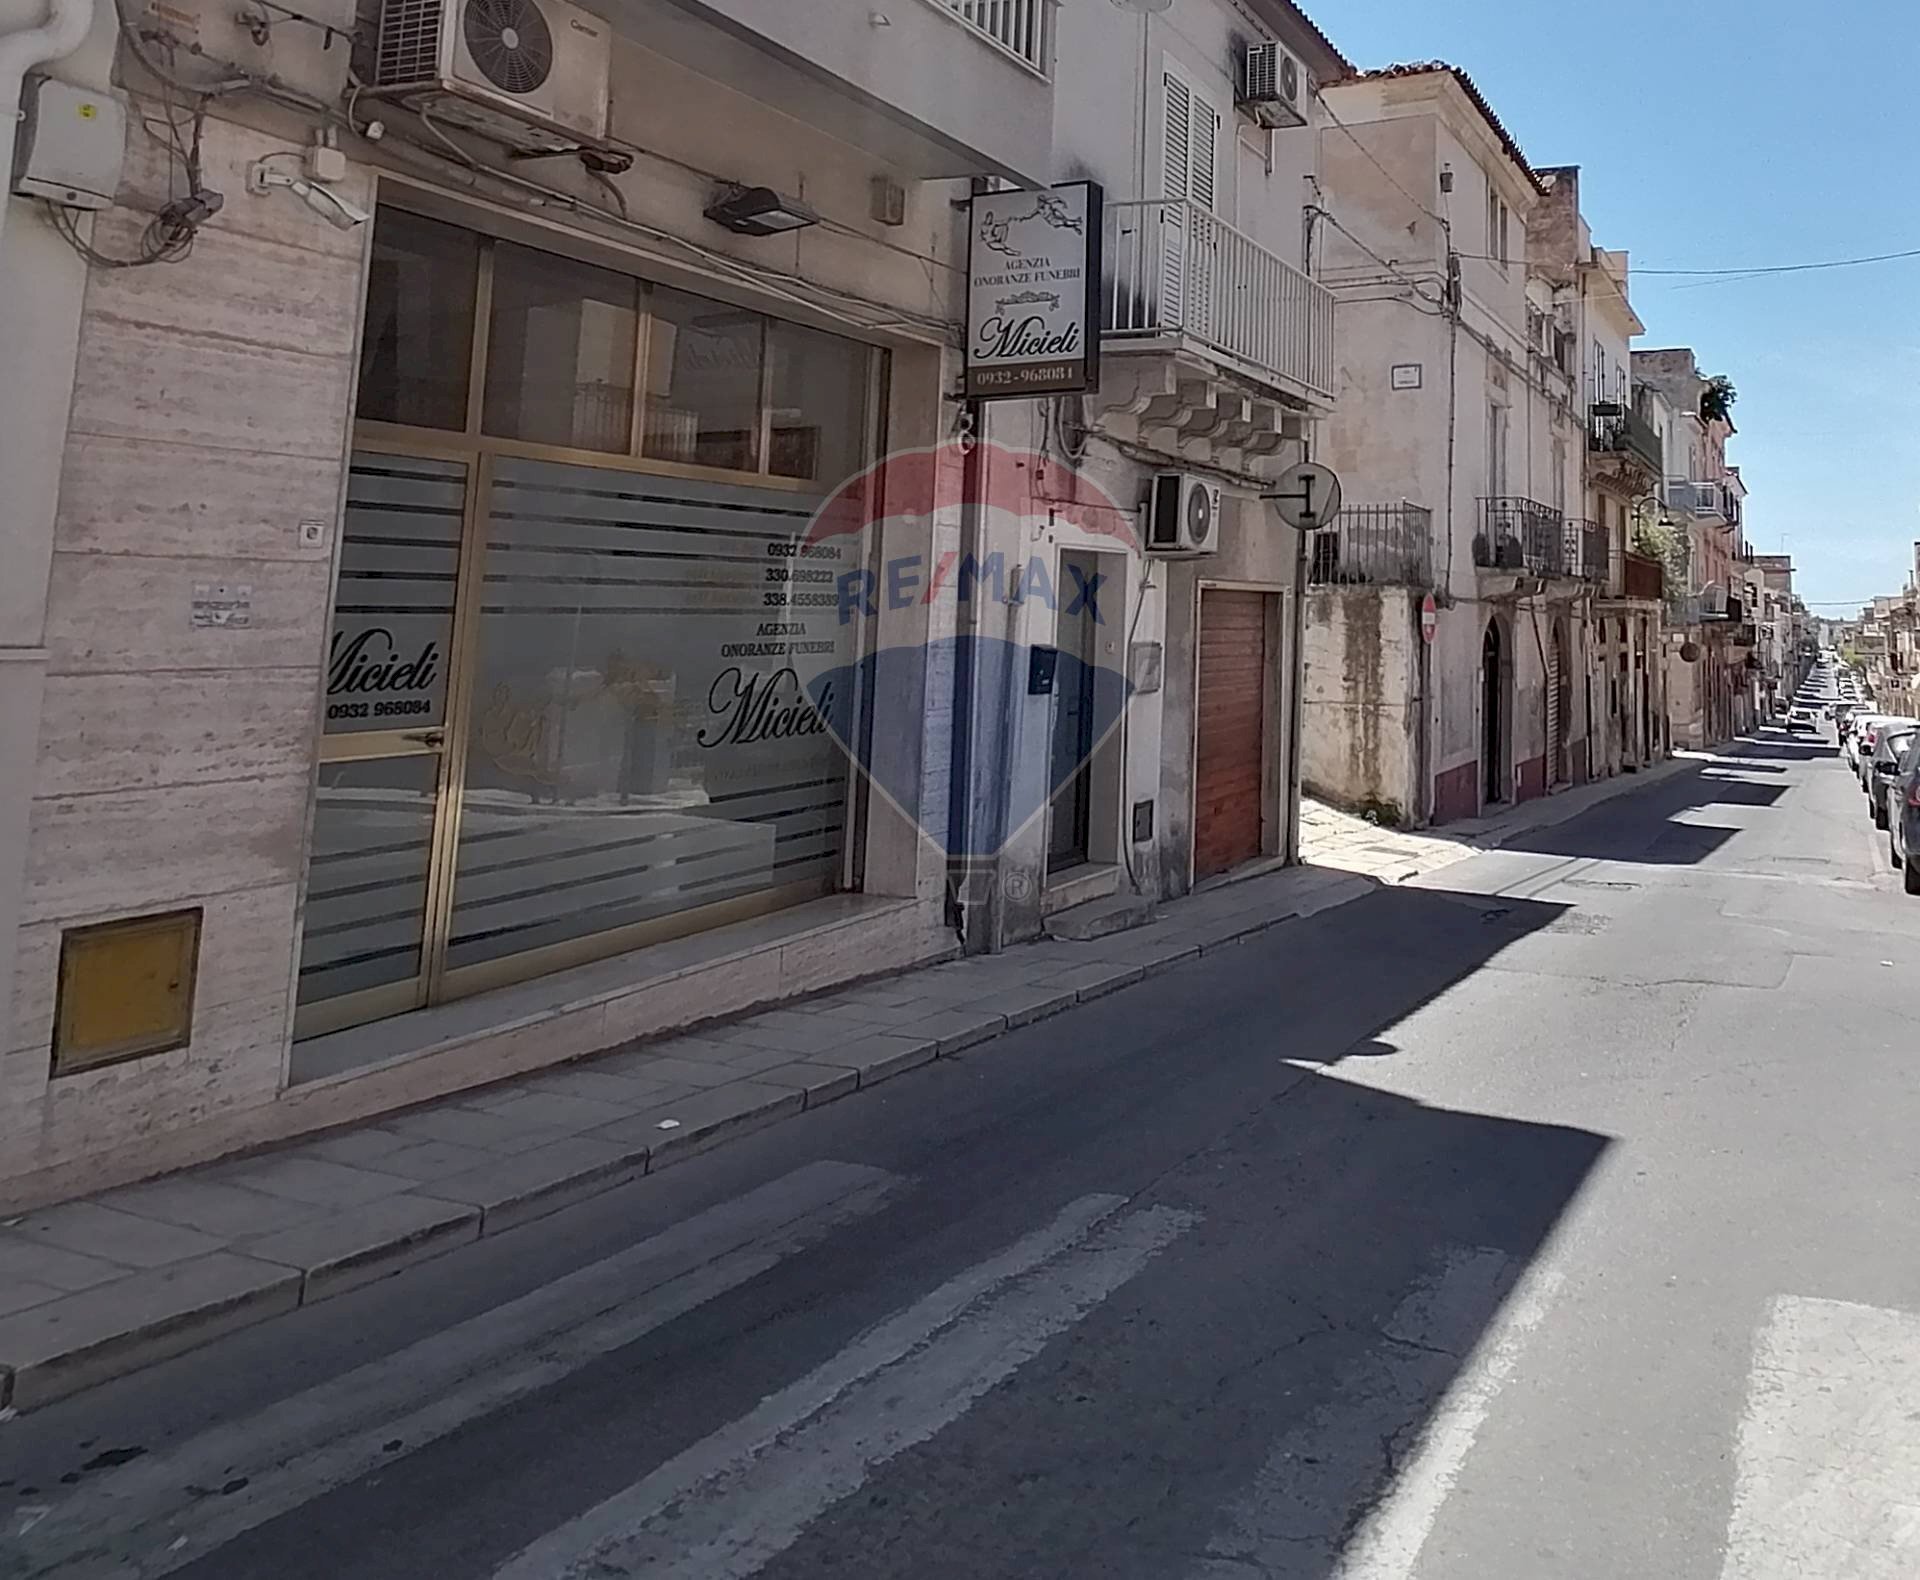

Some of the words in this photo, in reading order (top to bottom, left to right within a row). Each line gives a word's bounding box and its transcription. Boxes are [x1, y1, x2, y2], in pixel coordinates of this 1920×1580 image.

[1004, 257, 1051, 271] AGENZIA
[973, 272, 1032, 288] ONORANZE
[1034, 267, 1081, 283] FUNEBRI
[974, 315, 1080, 359] Micieli
[756, 622, 807, 636] AGENZIA
[721, 642, 786, 658] ONORANZE
[788, 641, 835, 655] FUNEBRI
[328, 702, 370, 720] 0932
[374, 698, 432, 717] 968084
[696, 667, 836, 749] Micieli
